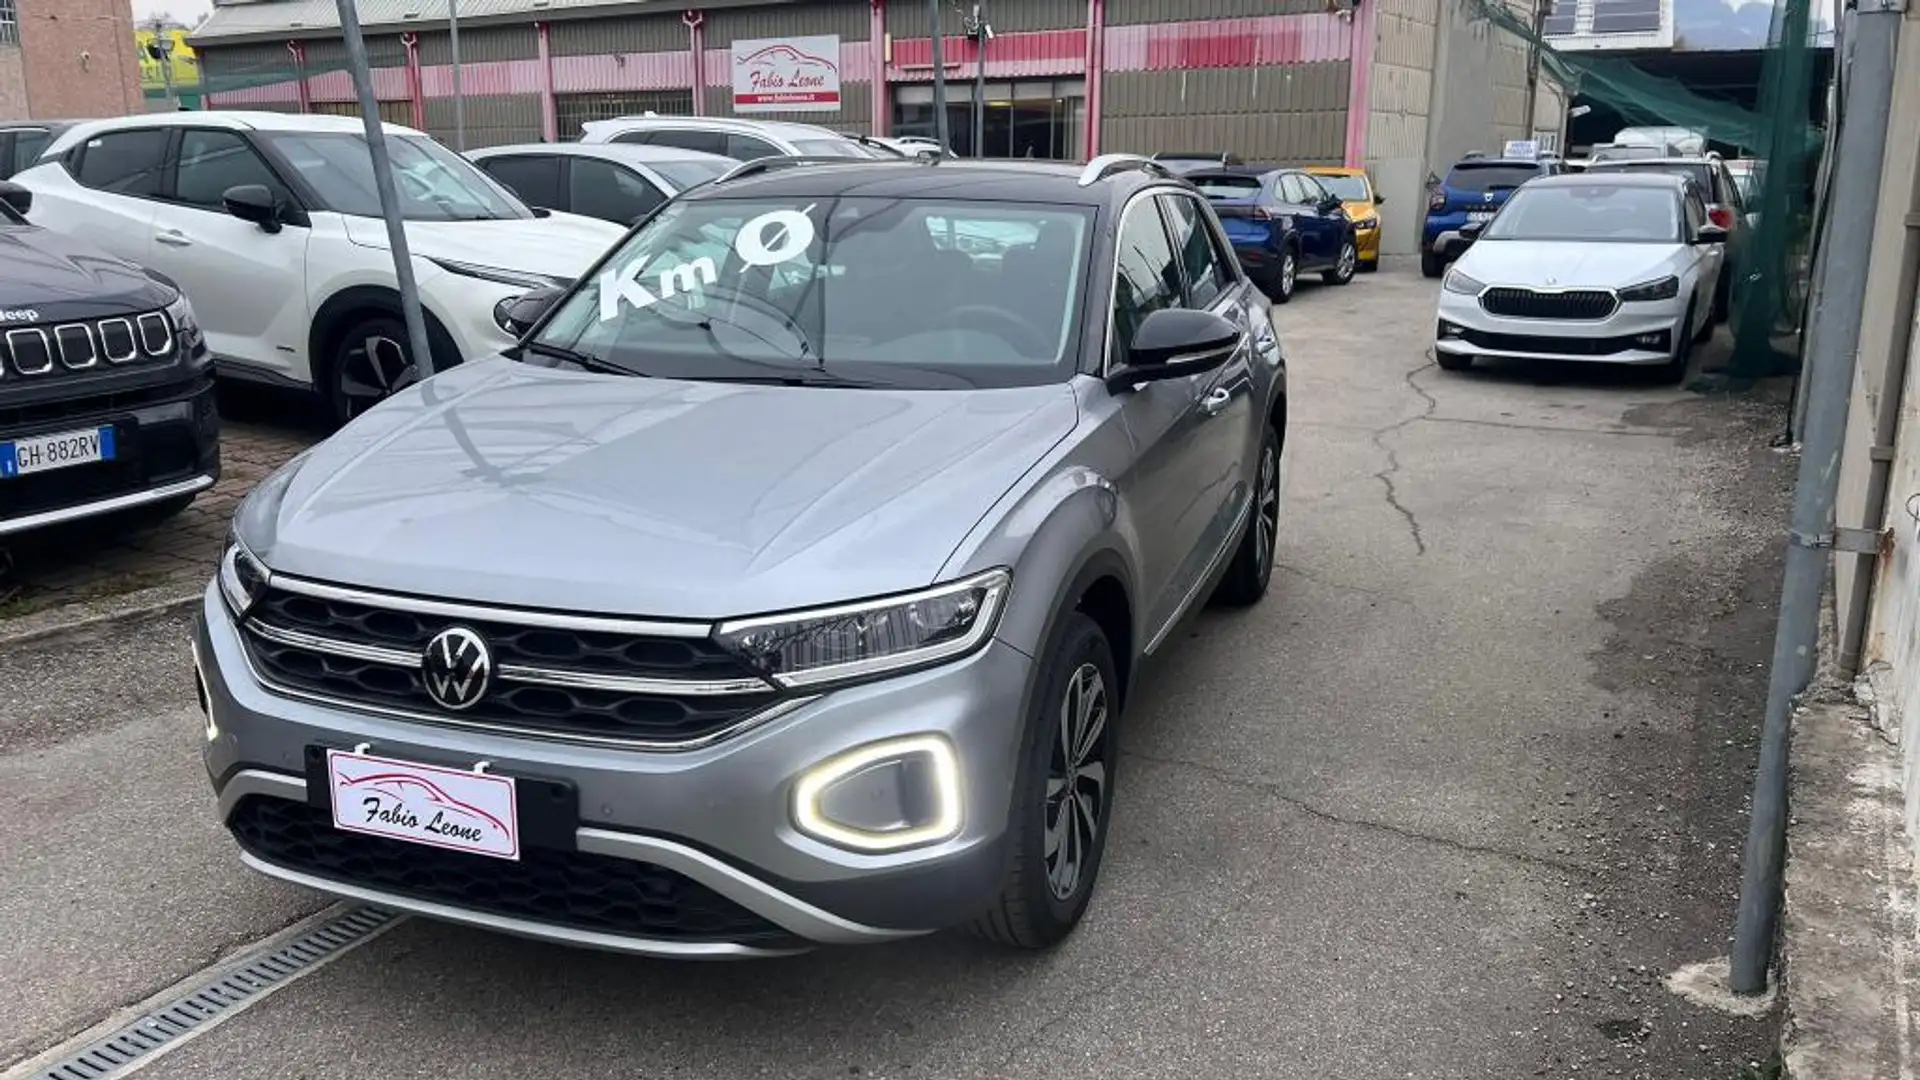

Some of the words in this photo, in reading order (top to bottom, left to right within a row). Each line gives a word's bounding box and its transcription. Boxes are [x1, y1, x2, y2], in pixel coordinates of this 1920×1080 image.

[750, 70, 783, 92] Fabio
[788, 67, 824, 87] Leone
[600, 255, 717, 322] Km
[363, 797, 419, 828] Fabio
[424, 811, 483, 842] Leone
